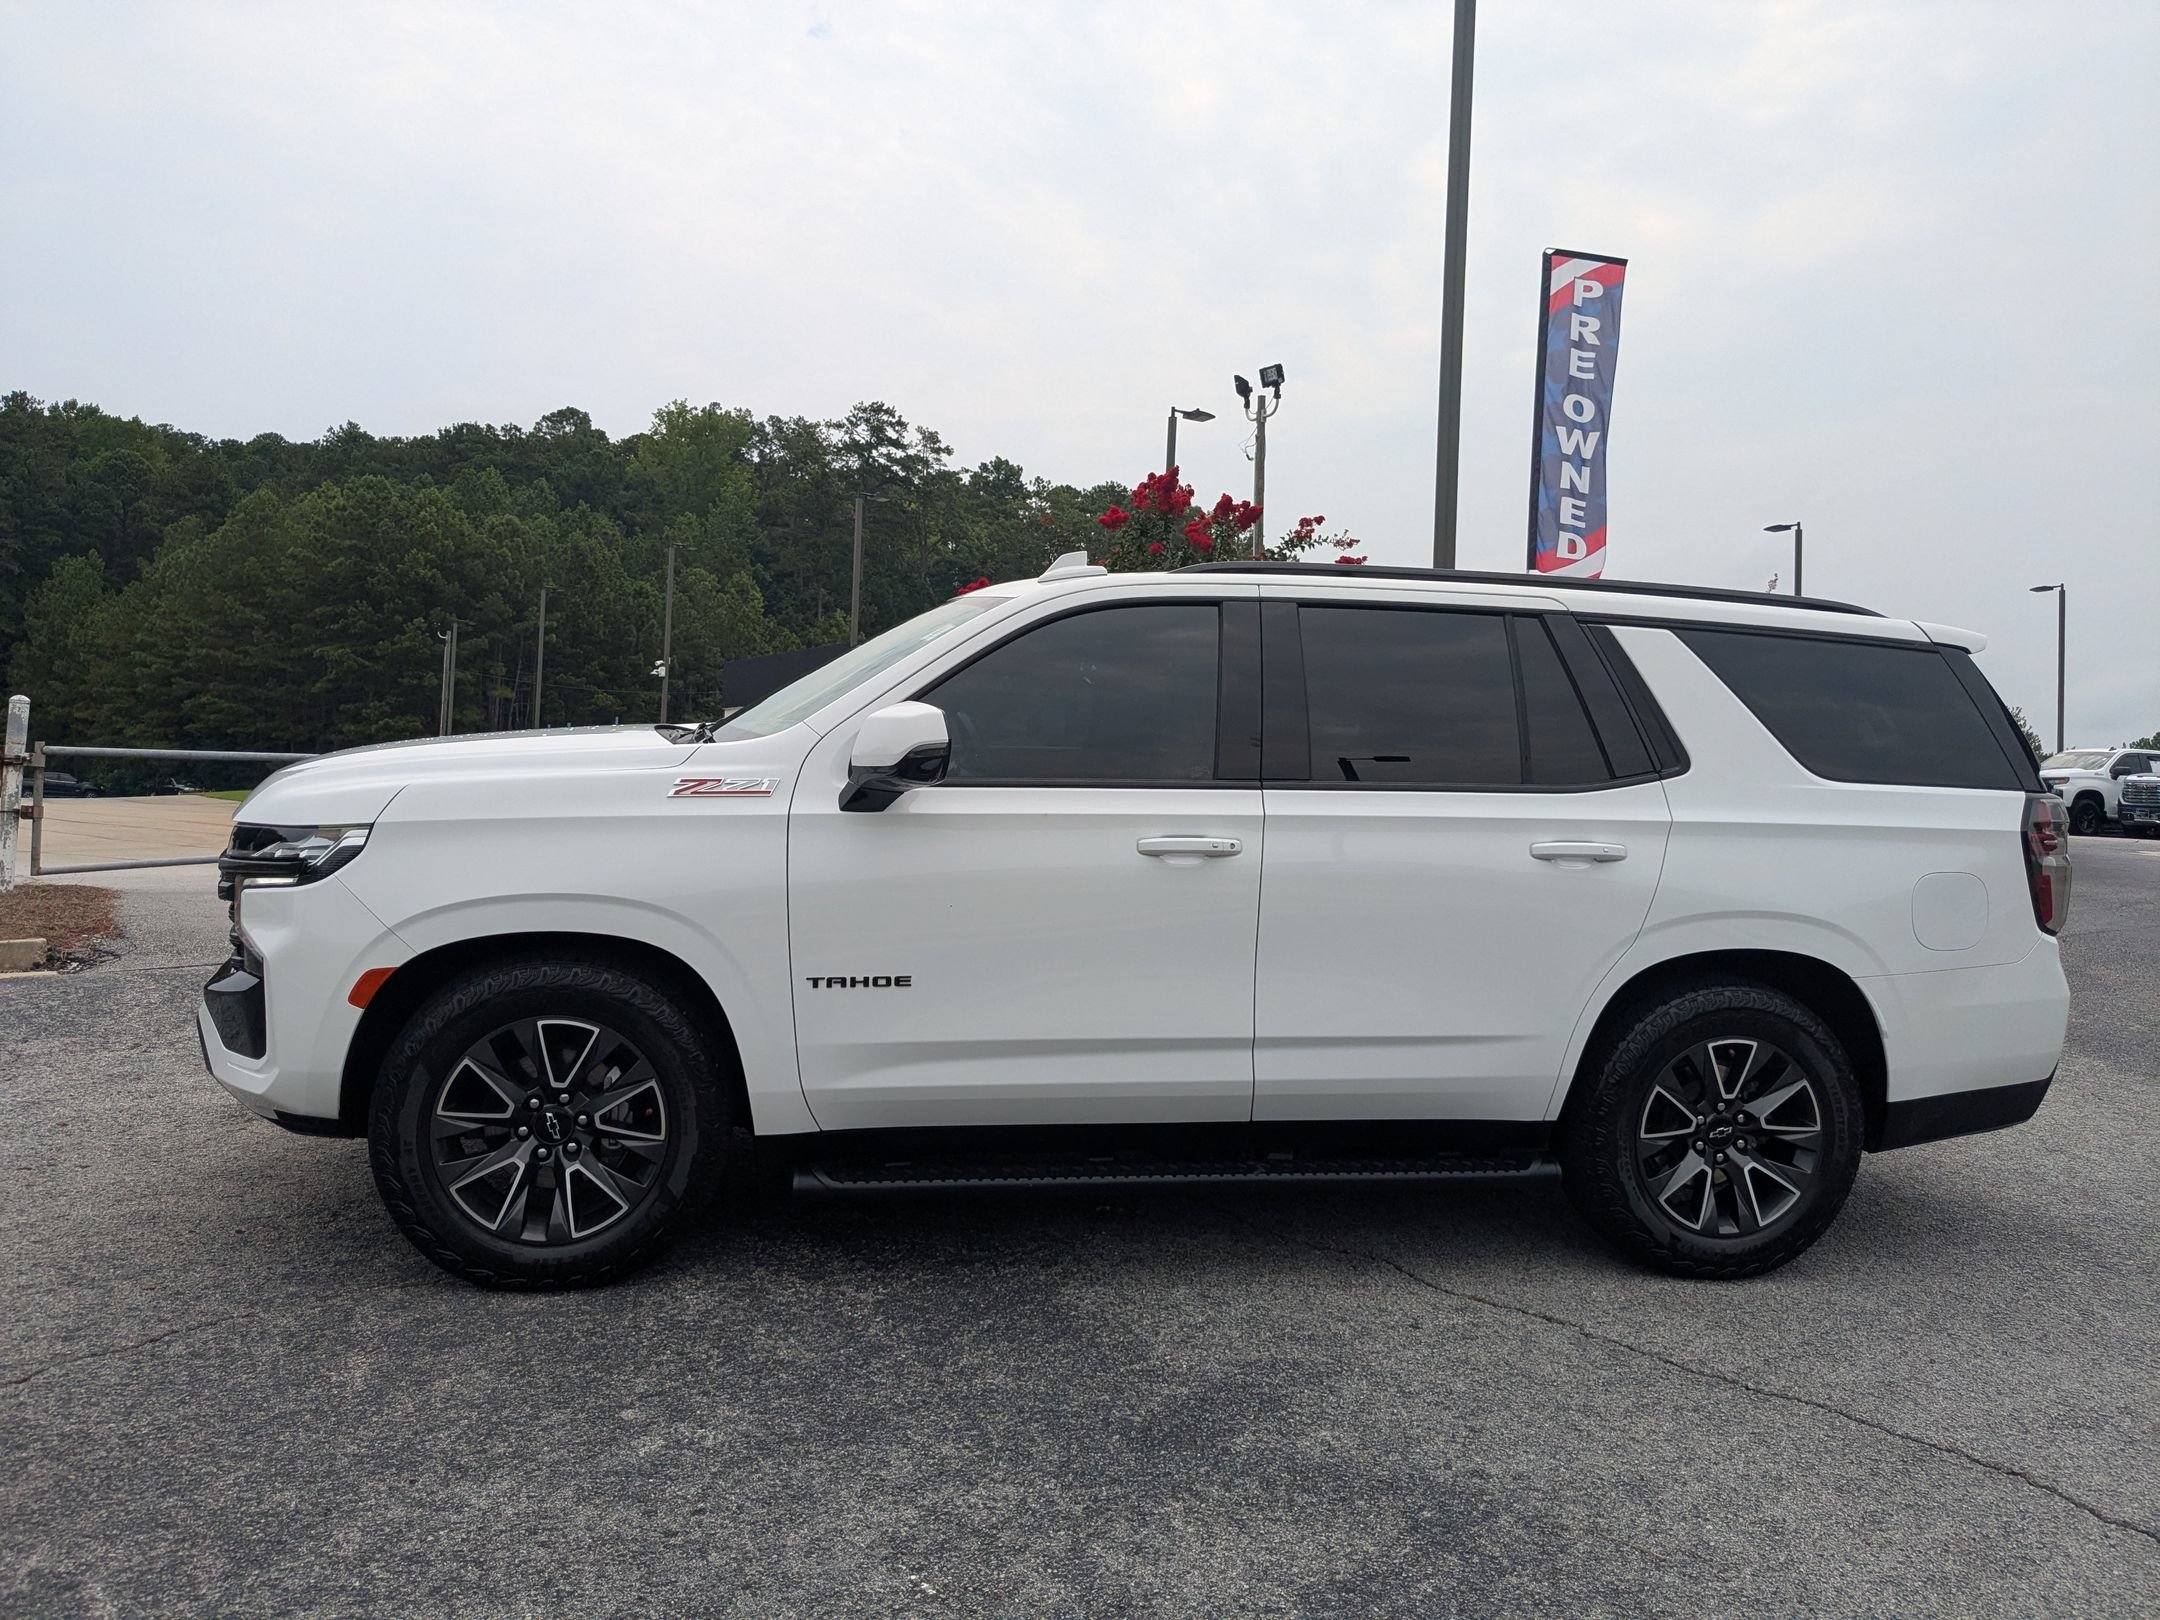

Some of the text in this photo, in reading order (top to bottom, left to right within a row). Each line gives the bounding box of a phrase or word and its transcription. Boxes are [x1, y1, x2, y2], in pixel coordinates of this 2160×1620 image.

[1555, 278, 1604, 561] PRE OWNED
[667, 778, 780, 798] Z71
[805, 975, 912, 989] TAHOE
